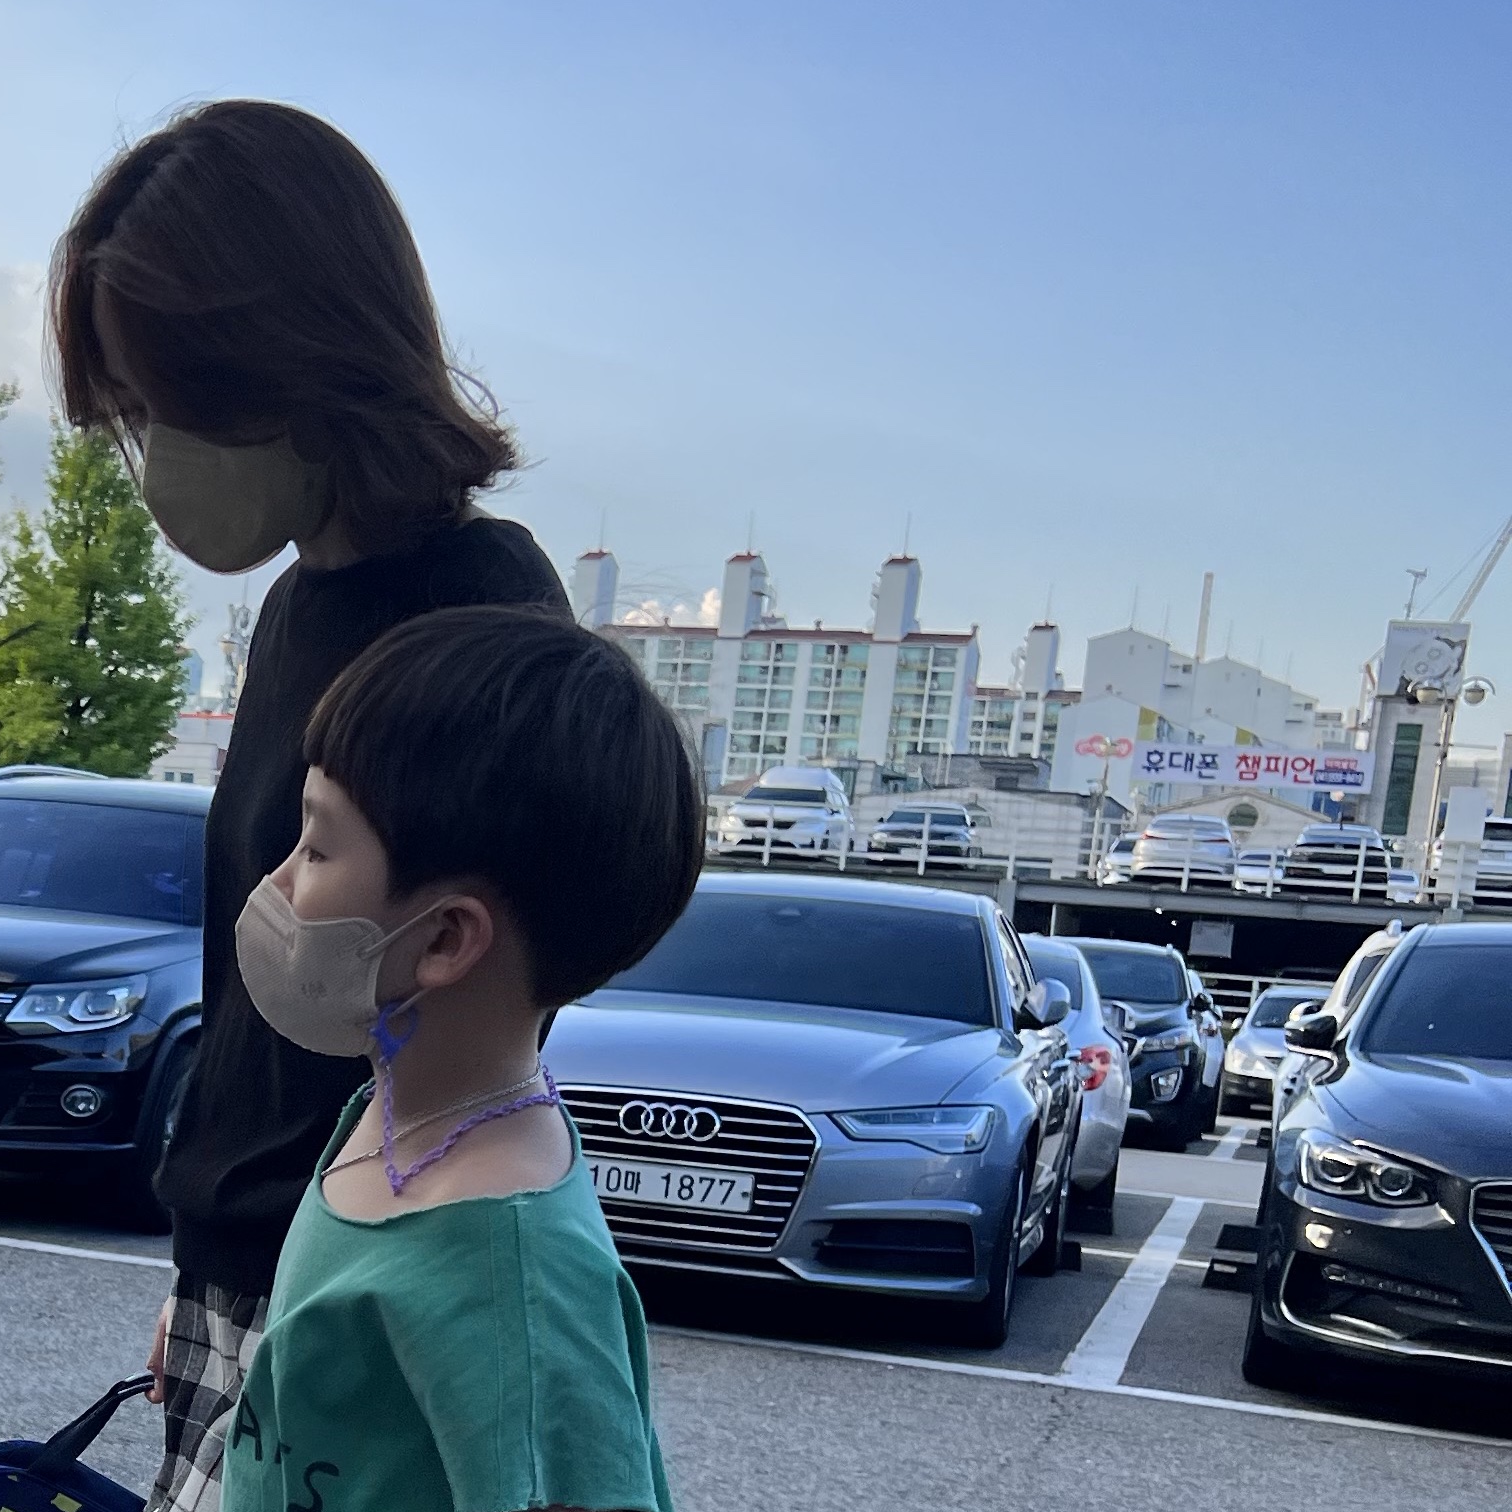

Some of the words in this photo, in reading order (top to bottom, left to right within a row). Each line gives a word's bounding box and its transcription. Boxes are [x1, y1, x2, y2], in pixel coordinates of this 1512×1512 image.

[1141, 749, 1220, 780] 휴대폰
[1235, 752, 1316, 785] 챔피언
[589, 1164, 641, 1195] 10마
[660, 1172, 736, 1206] 1877
